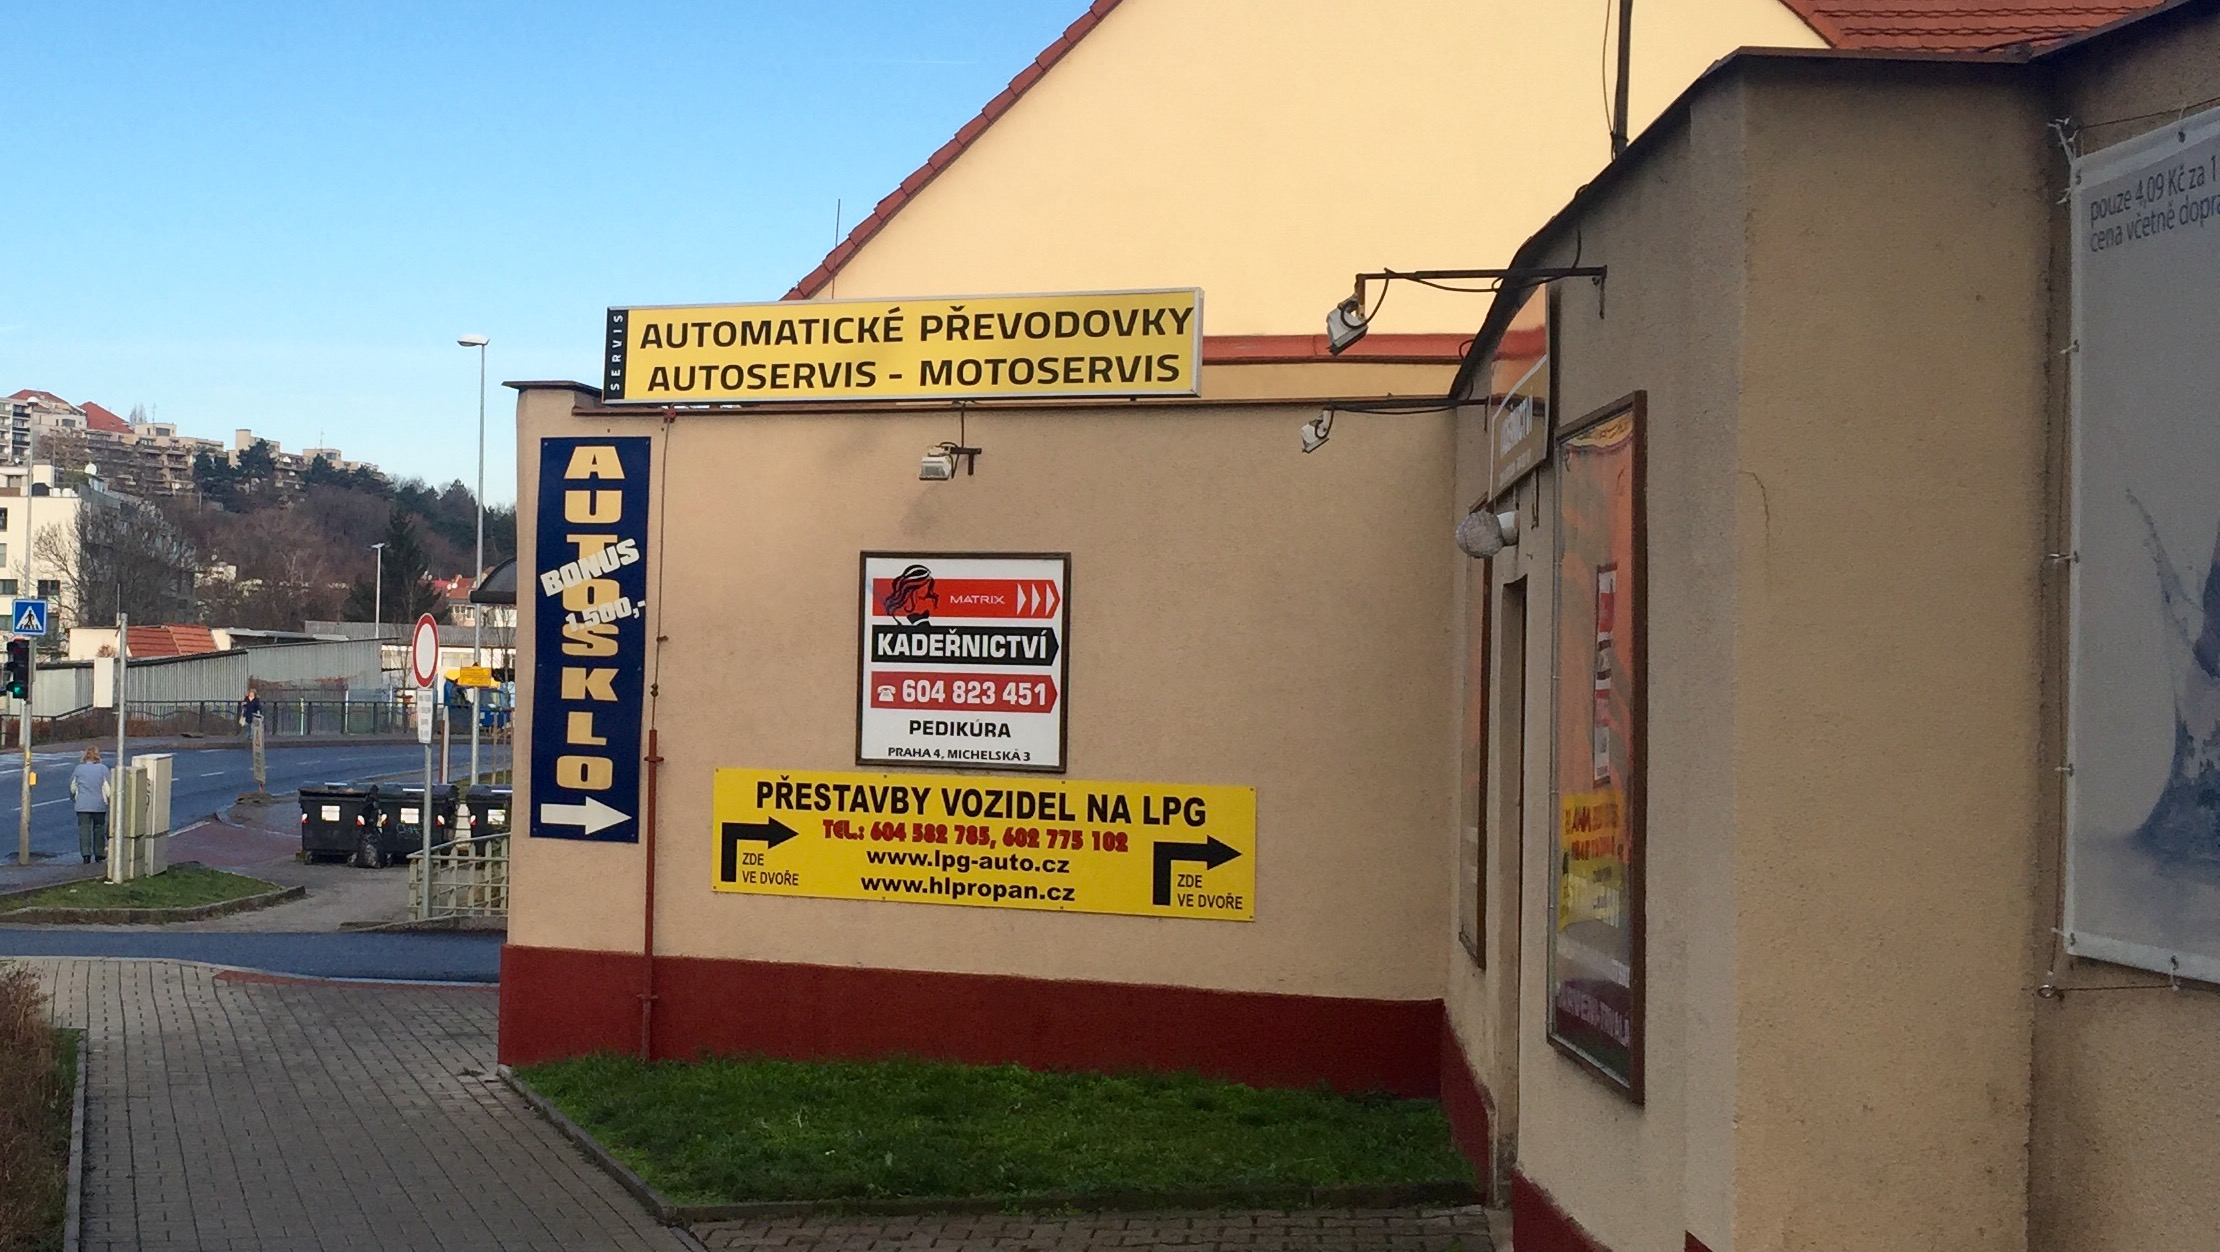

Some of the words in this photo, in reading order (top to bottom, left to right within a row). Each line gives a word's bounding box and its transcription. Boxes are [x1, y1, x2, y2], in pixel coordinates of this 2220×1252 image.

[2090, 190, 2132, 229] pouze
[2168, 164, 2186, 197] Kč
[2188, 165, 2206, 190] za
[2090, 225, 2123, 253] cena
[2126, 200, 2176, 241] včetně
[640, 307, 904, 350] AUTOMATICKÉ
[919, 305, 1194, 342] PŘEVODOVKY
[610, 314, 623, 391] SERVIS
[647, 361, 877, 392] AUTOSERVIS
[919, 353, 1181, 387] MOTOSERVIS
[540, 538, 640, 597] BONUS
[565, 596, 647, 632] 1.500,-
[950, 595, 1005, 604] MATRIX
[555, 445, 625, 791] AUTOSKLO
[877, 629, 1047, 659] KADEŘNICTVÍ
[902, 679, 945, 703] 604
[952, 681, 996, 704] 823
[1002, 682, 1046, 705] 451
[909, 719, 1011, 738] PEDIKÚRA
[888, 747, 931, 758] PRAHA
[933, 749, 945, 760] 4,
[947, 748, 1020, 761] MICHELSKÁ
[1024, 752, 1031, 762] 3
[756, 775, 931, 815] PŘESTAVBY
[941, 788, 1076, 822] VOZIDEL
[1087, 793, 1131, 824] NA
[1143, 796, 1206, 827] LPG
[822, 819, 865, 841] TEL.:
[870, 821, 907, 843] 604
[912, 823, 948, 844] 582
[954, 824, 997, 849] 785,
[1002, 826, 1040, 848] 602
[1046, 828, 1084, 850] 775
[1091, 830, 1128, 852] 102
[742, 852, 764, 866] ZDE
[866, 849, 1070, 874] www.lpg-auto.cz
[742, 870, 756, 883] VE
[760, 870, 799, 886] DVOŘE
[860, 875, 1075, 901] www.hlpropan.cz
[1177, 874, 1202, 888] ZDE
[1177, 893, 1194, 907] VE
[1198, 892, 1243, 910] DVOŘE
